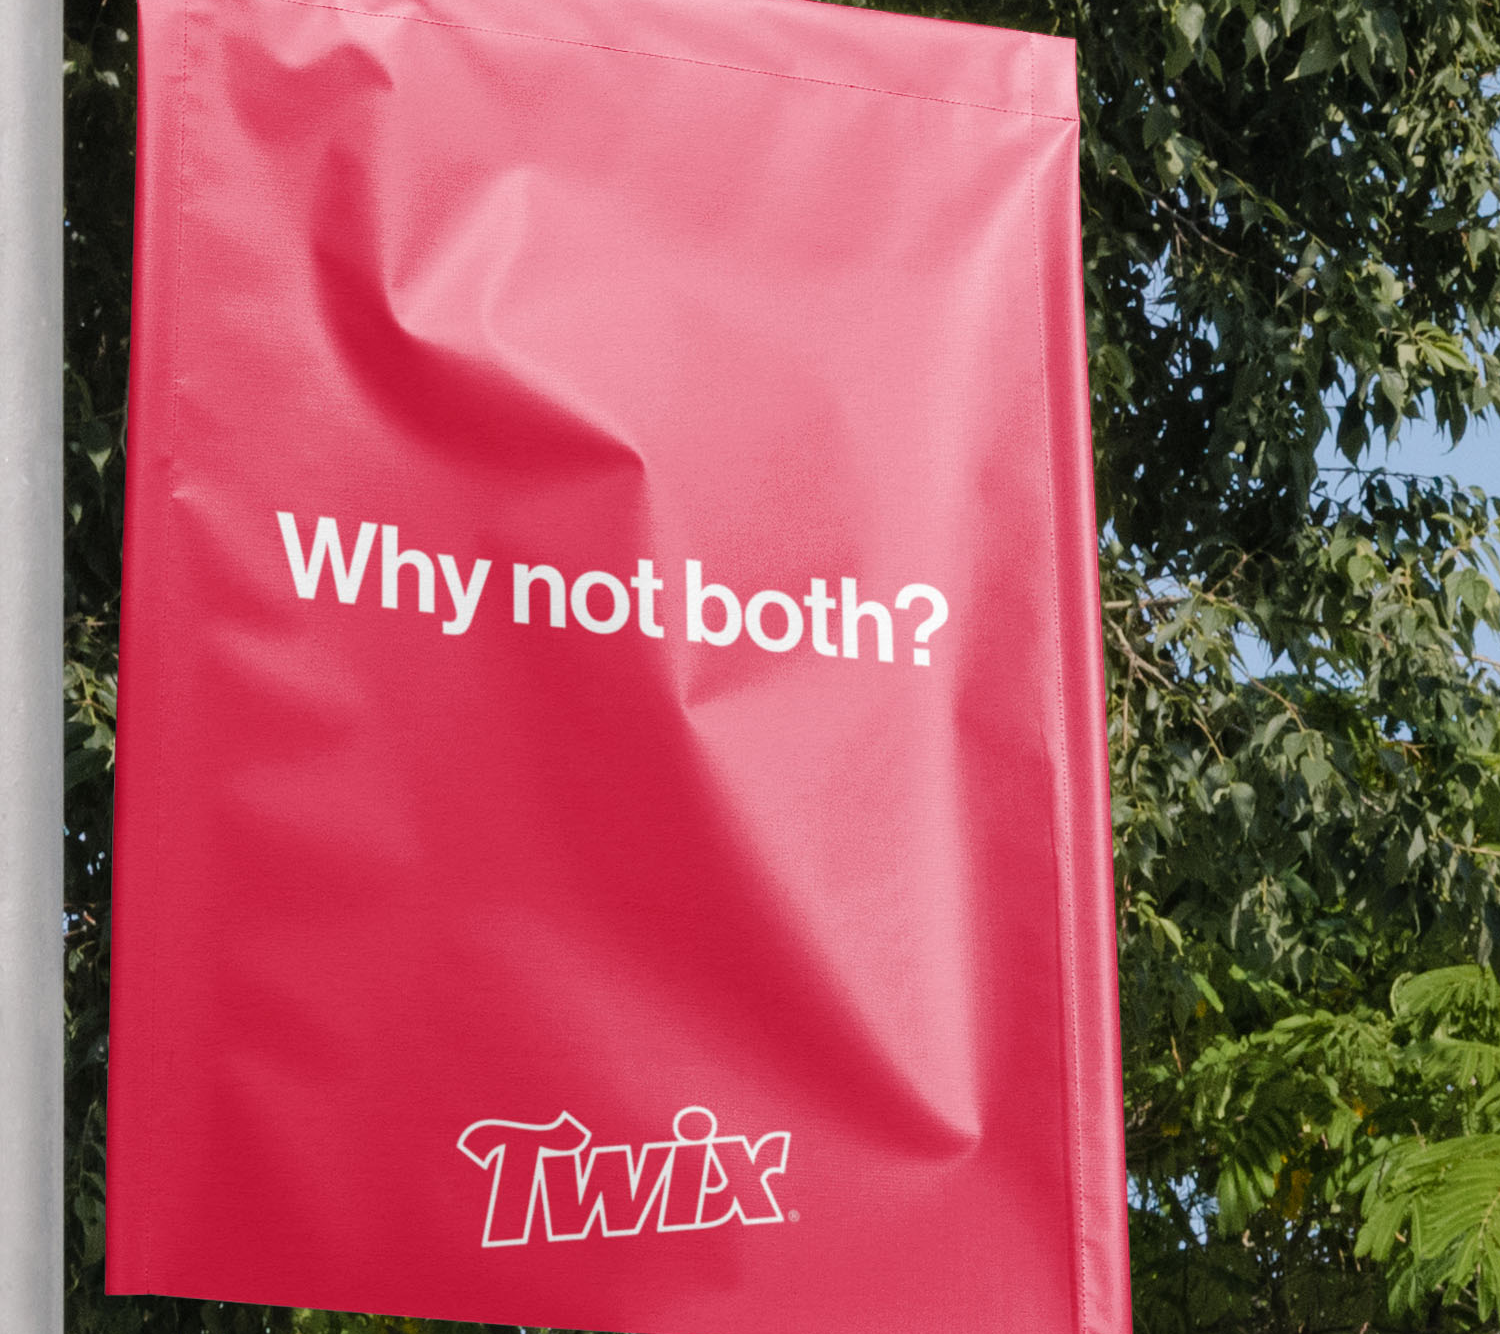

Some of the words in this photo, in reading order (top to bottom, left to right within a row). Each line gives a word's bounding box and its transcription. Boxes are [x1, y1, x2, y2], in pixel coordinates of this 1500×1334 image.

[276, 511, 491, 635] Why
[511, 559, 665, 639] not
[684, 559, 950, 667] both?
[456, 1105, 792, 1249] Twix
